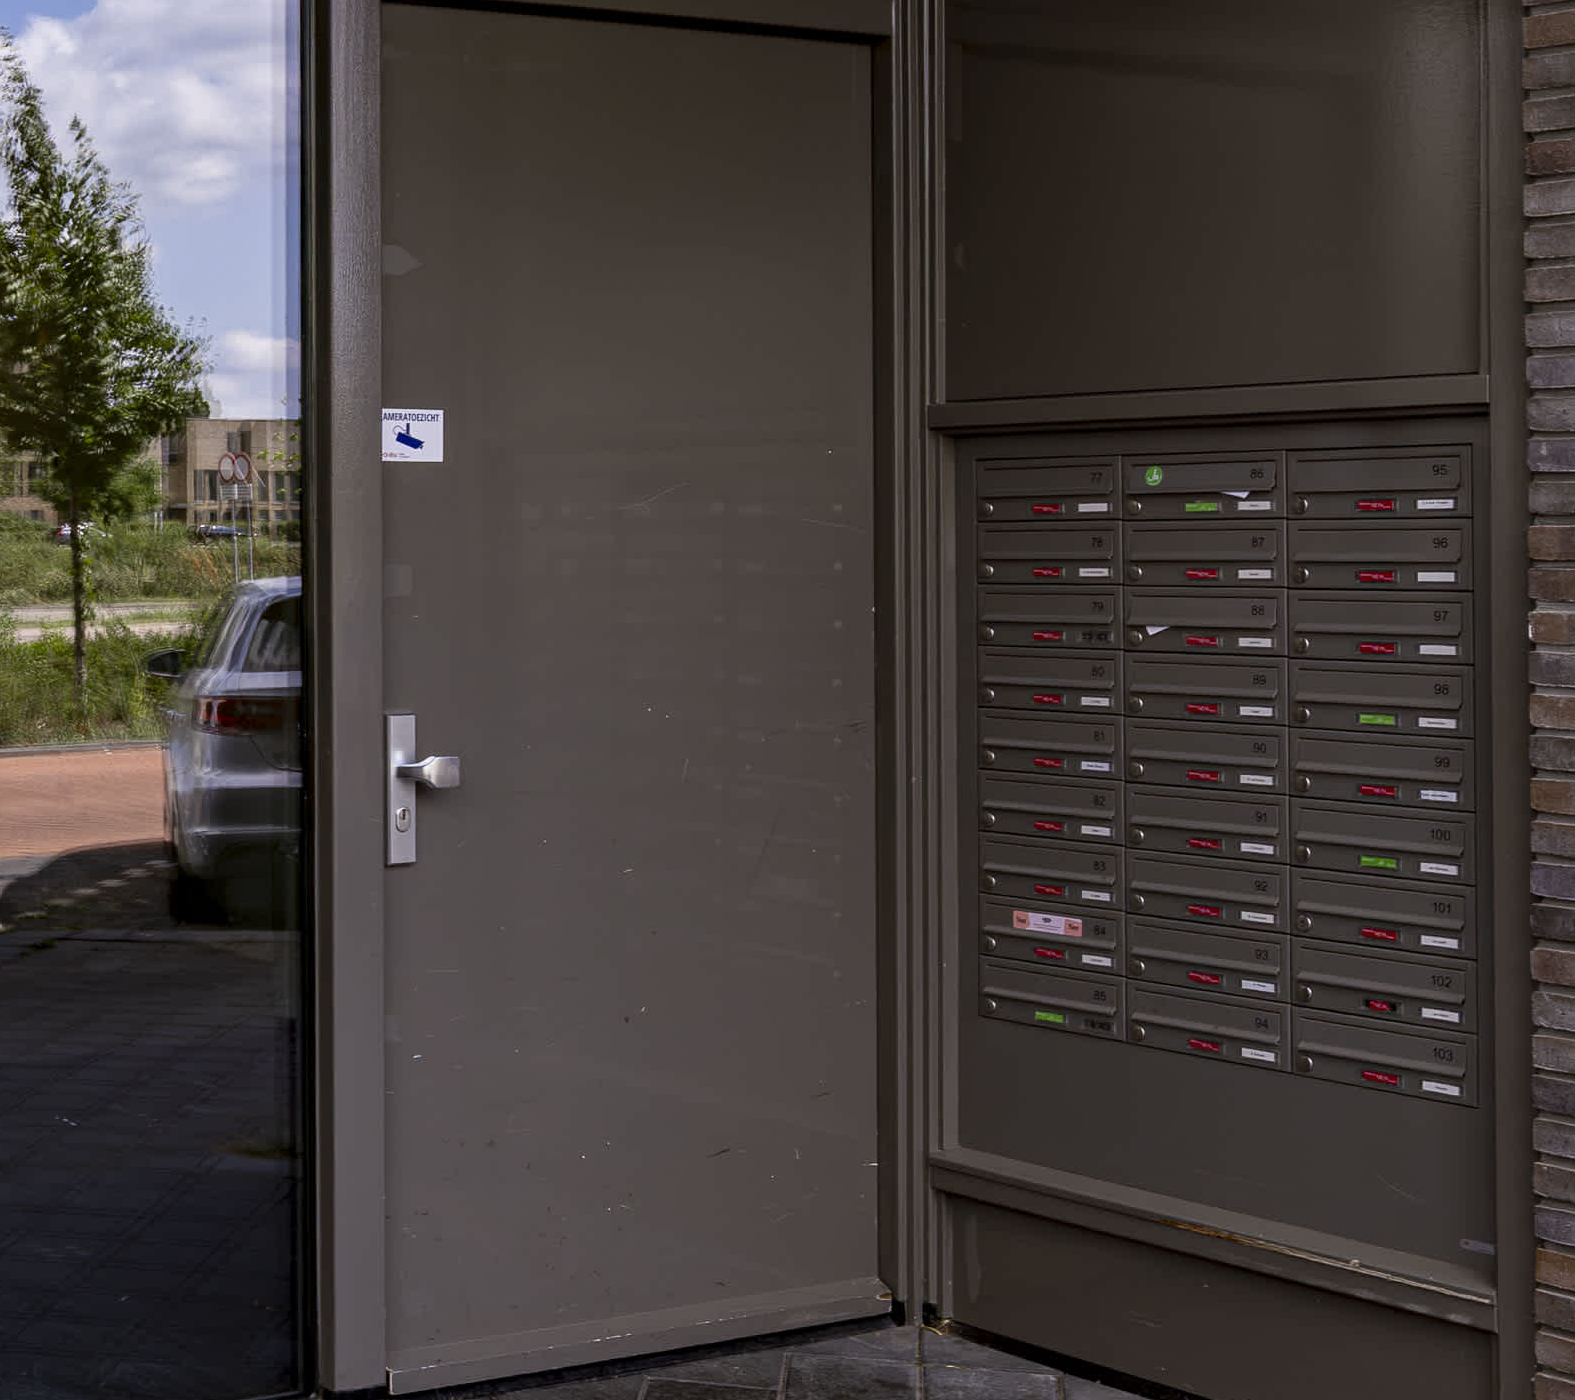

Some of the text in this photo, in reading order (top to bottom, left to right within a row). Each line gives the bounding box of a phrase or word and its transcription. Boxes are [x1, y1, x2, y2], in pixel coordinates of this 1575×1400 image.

[382, 412, 440, 423] AMERATOEZICHT
[1249, 468, 1264, 480] 86
[1432, 464, 1447, 476] 95
[1251, 536, 1266, 548] 87
[1432, 537, 1449, 549] 96
[1251, 604, 1265, 616] 88
[1433, 610, 1449, 622] 97
[1252, 674, 1267, 686] 89
[1433, 683, 1450, 696] 98
[1252, 742, 1267, 754] 90
[1434, 756, 1451, 768] 99
[1255, 811, 1267, 823] 91
[1430, 828, 1451, 841] 100
[1254, 880, 1268, 892] 92
[1433, 902, 1451, 914] 101
[1255, 948, 1269, 961] 93
[1431, 975, 1452, 989] 102
[1254, 1017, 1269, 1030] 94
[1433, 1047, 1453, 1061] 103
